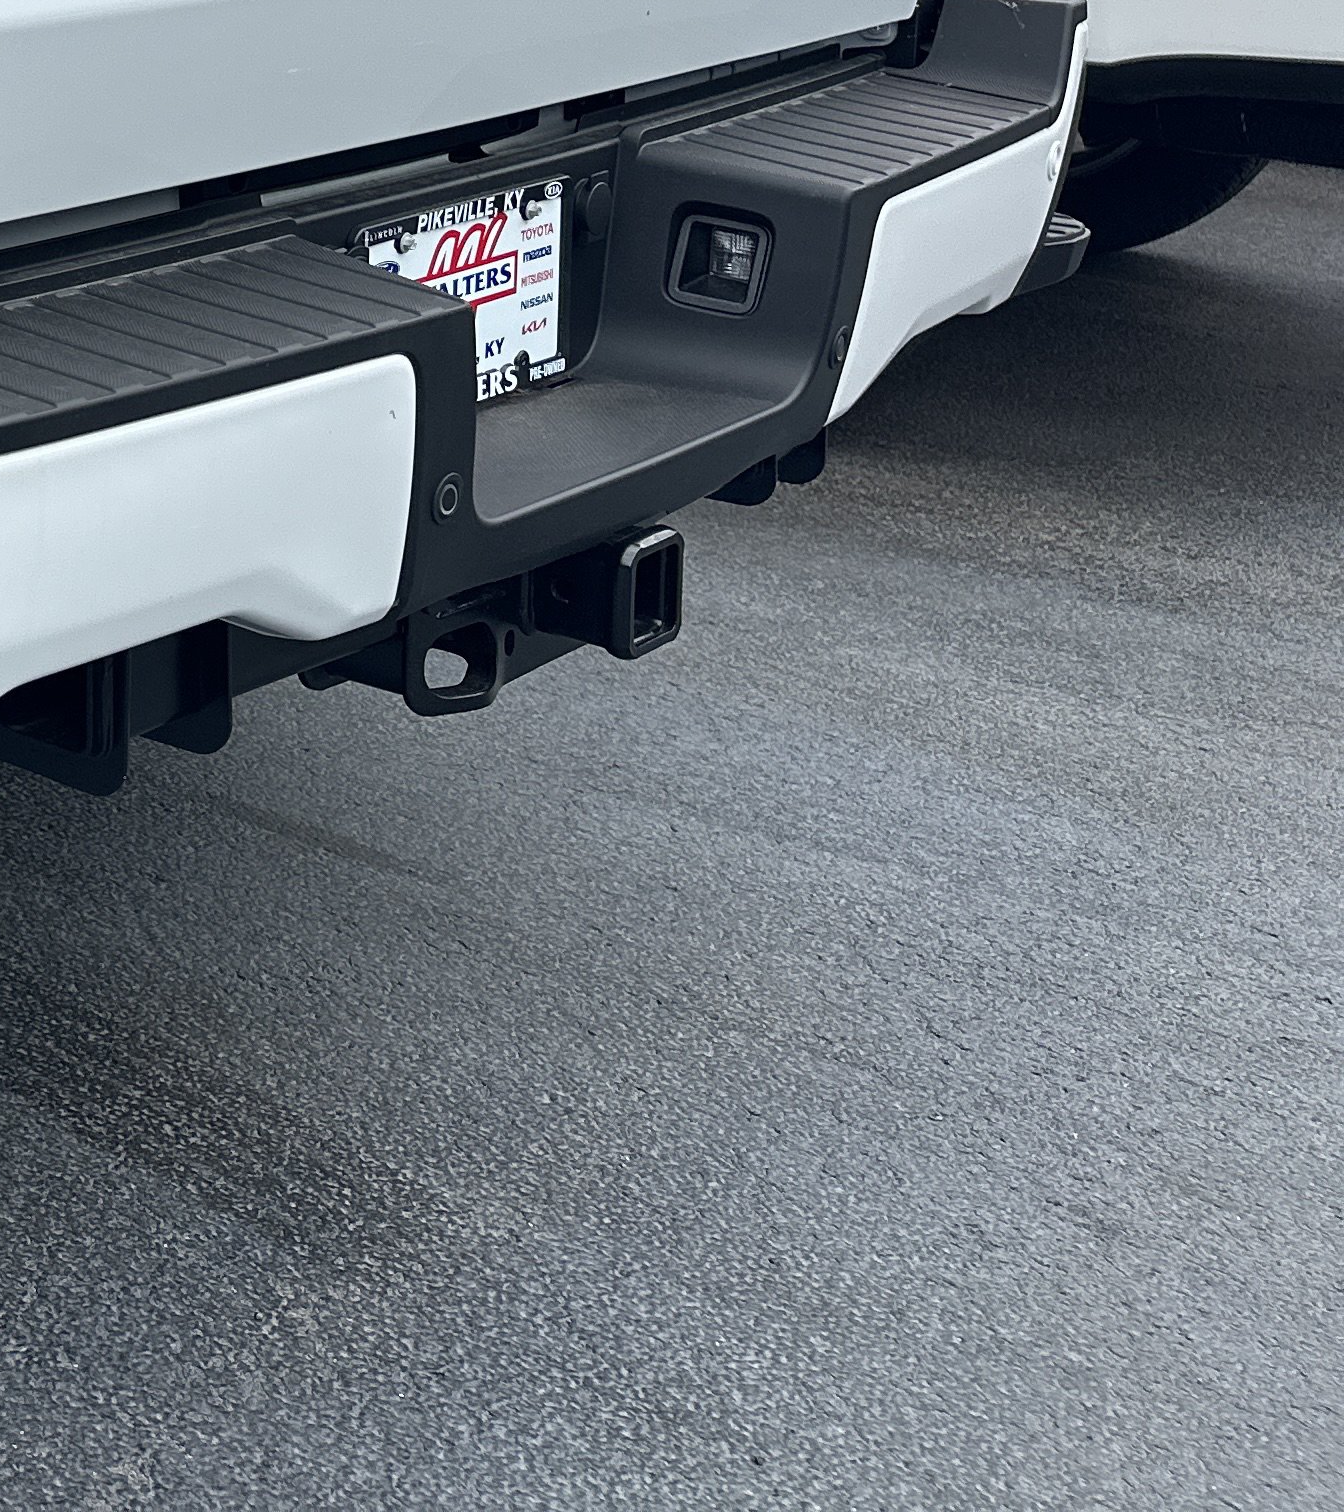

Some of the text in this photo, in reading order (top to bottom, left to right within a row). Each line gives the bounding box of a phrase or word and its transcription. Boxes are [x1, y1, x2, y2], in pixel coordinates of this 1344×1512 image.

[417, 188, 525, 234] PIKEVILLE, KY
[370, 226, 404, 243] LINCOLN
[520, 222, 554, 242] TOYOTA
[520, 292, 554, 311] NISSAN
[484, 336, 505, 360] KY
